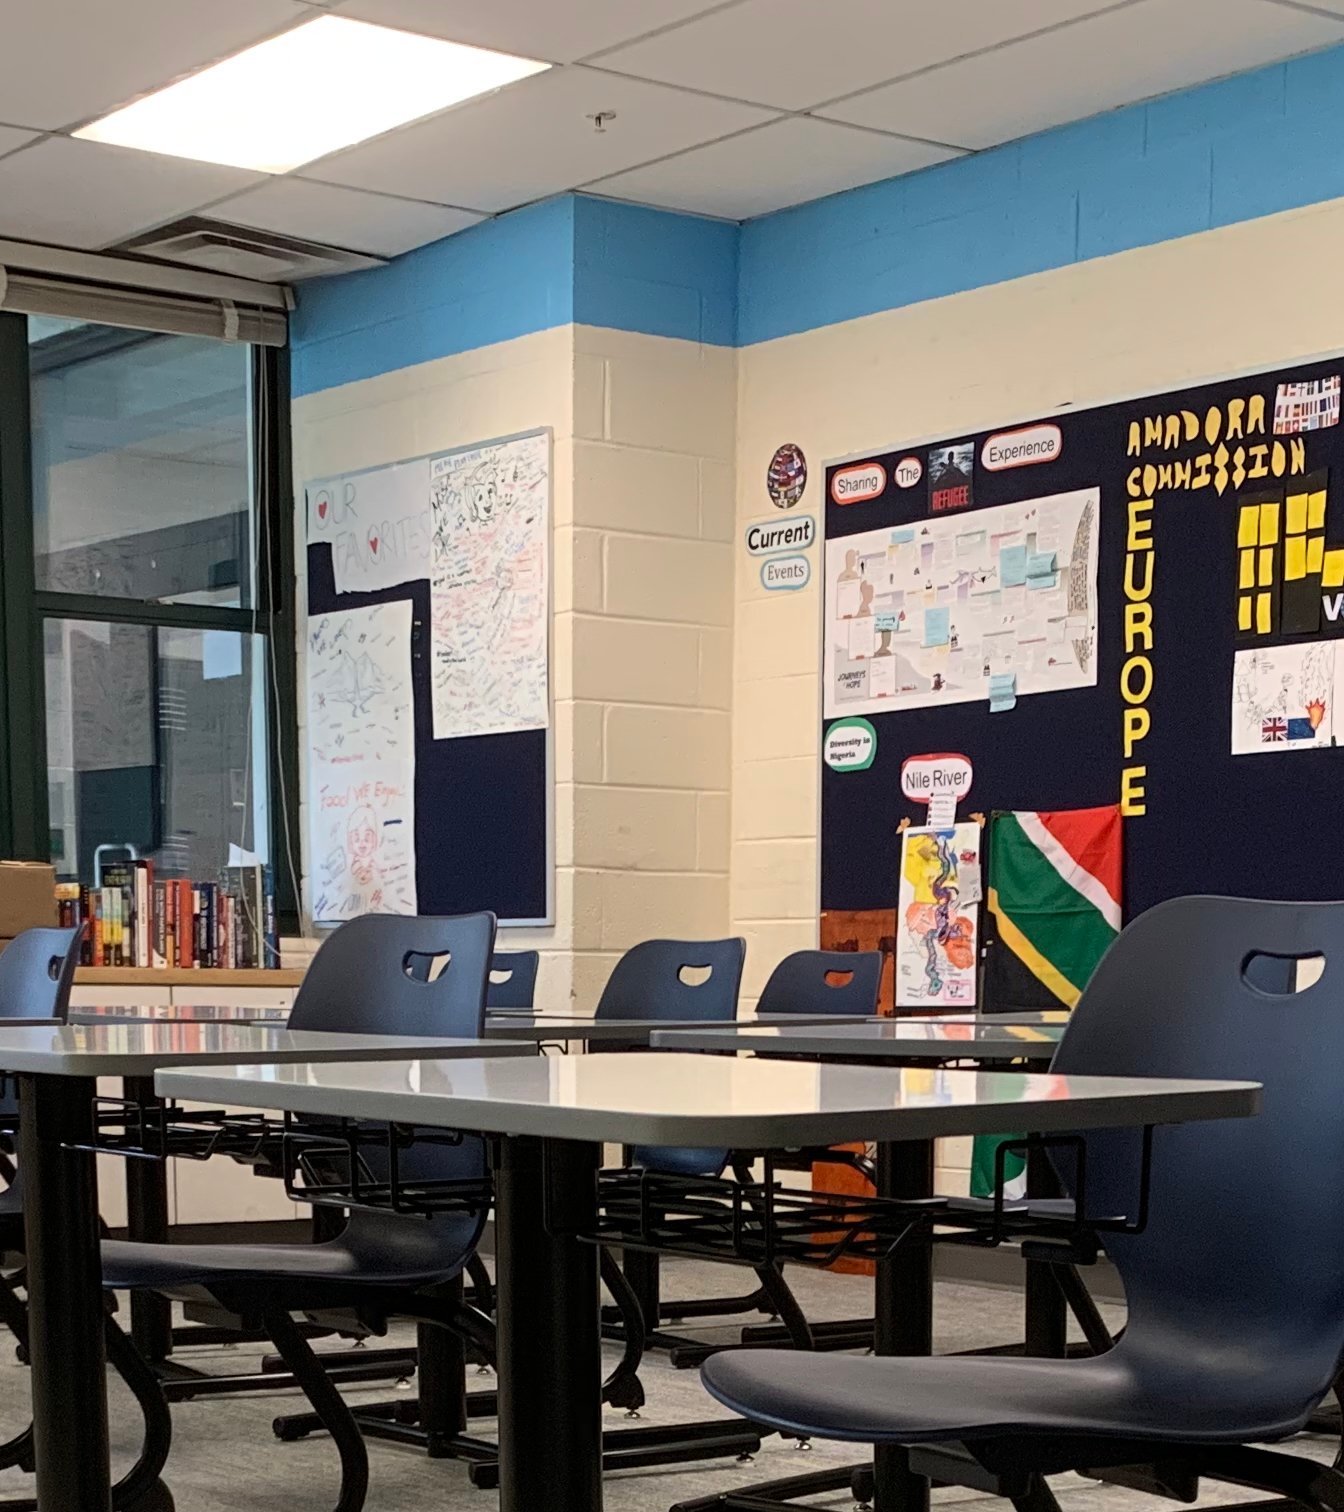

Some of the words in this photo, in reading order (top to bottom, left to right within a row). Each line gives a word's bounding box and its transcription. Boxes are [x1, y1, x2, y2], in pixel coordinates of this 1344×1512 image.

[1127, 394, 1265, 457] AMADORA
[988, 437, 1055, 463] Experience
[898, 466, 920, 483] The
[1126, 437, 1305, 497] COMMISSION
[837, 475, 878, 494] Sharing
[314, 482, 359, 530] OUR
[932, 485, 969, 511] REFUGEE
[748, 521, 810, 550] Current
[767, 565, 805, 581] Events
[1121, 498, 1155, 818] EUROPE
[829, 738, 862, 749] Diversity
[905, 772, 930, 790] Nile
[933, 768, 968, 786] River
